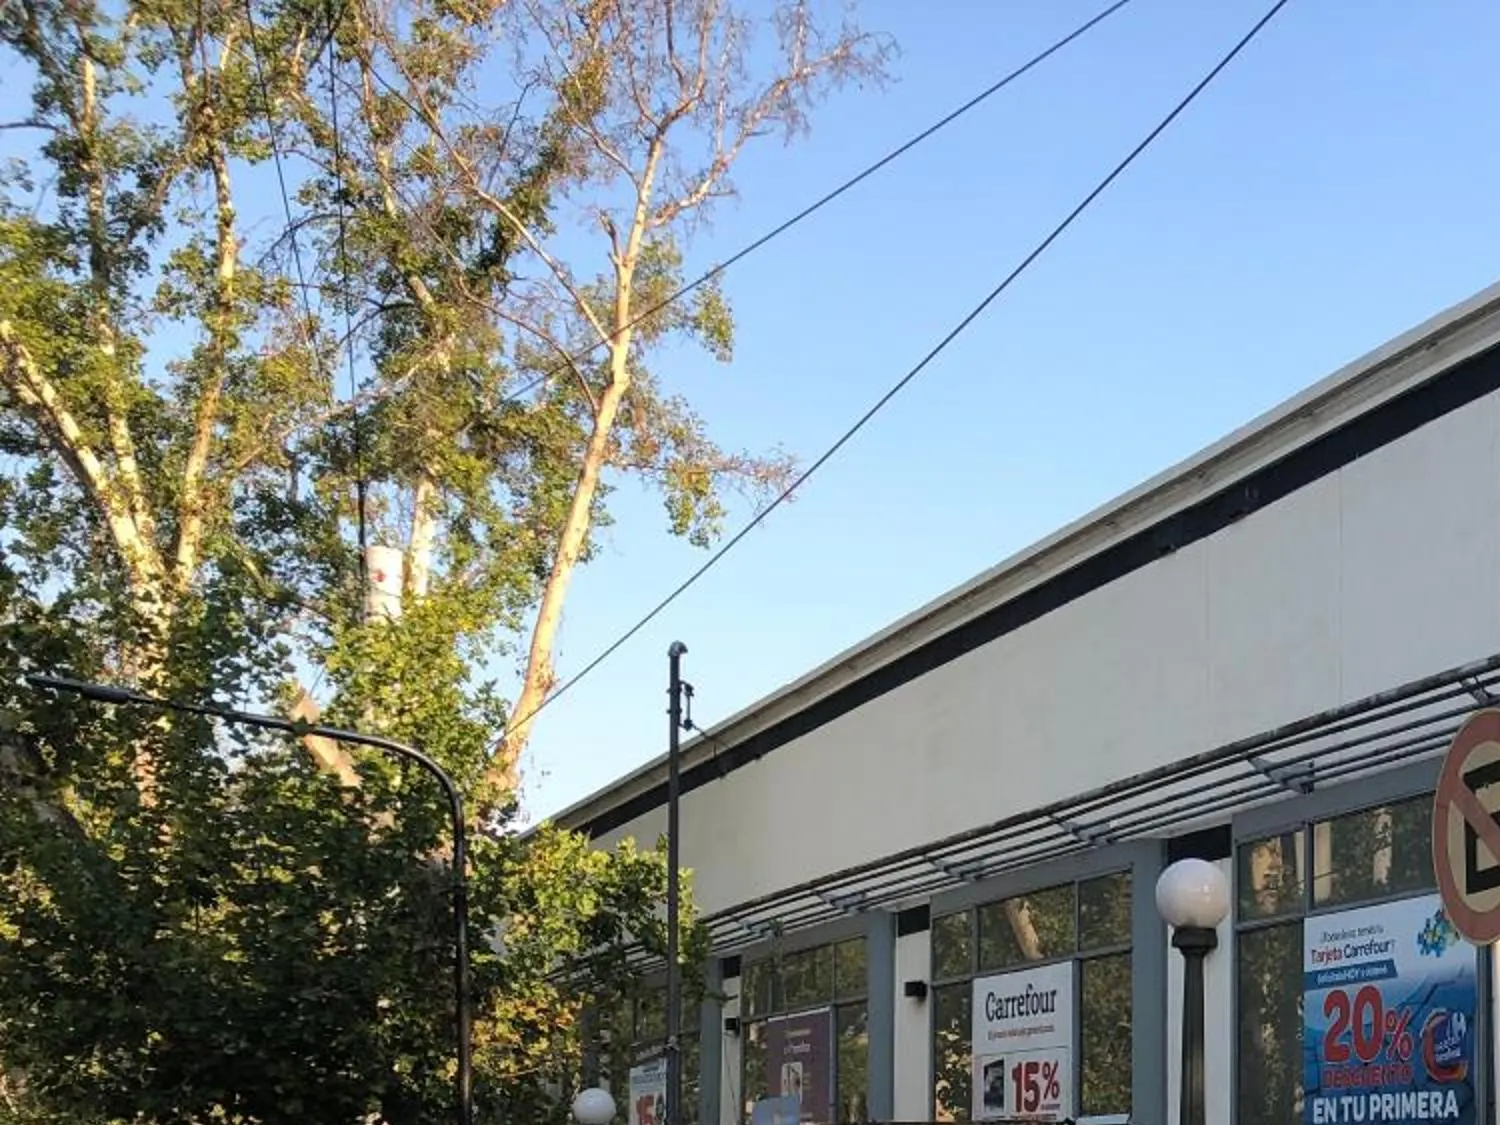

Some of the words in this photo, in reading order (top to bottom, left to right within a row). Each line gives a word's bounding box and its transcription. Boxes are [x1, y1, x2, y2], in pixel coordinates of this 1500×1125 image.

[985, 983, 1057, 1022] Carrefour
[1323, 985, 1414, 1064] 20%
[1011, 1060, 1060, 1113] 15%
[1313, 1097, 1337, 1124] EN
[1341, 1095, 1365, 1122] TU
[1369, 1089, 1459, 1121] PRIMERA
